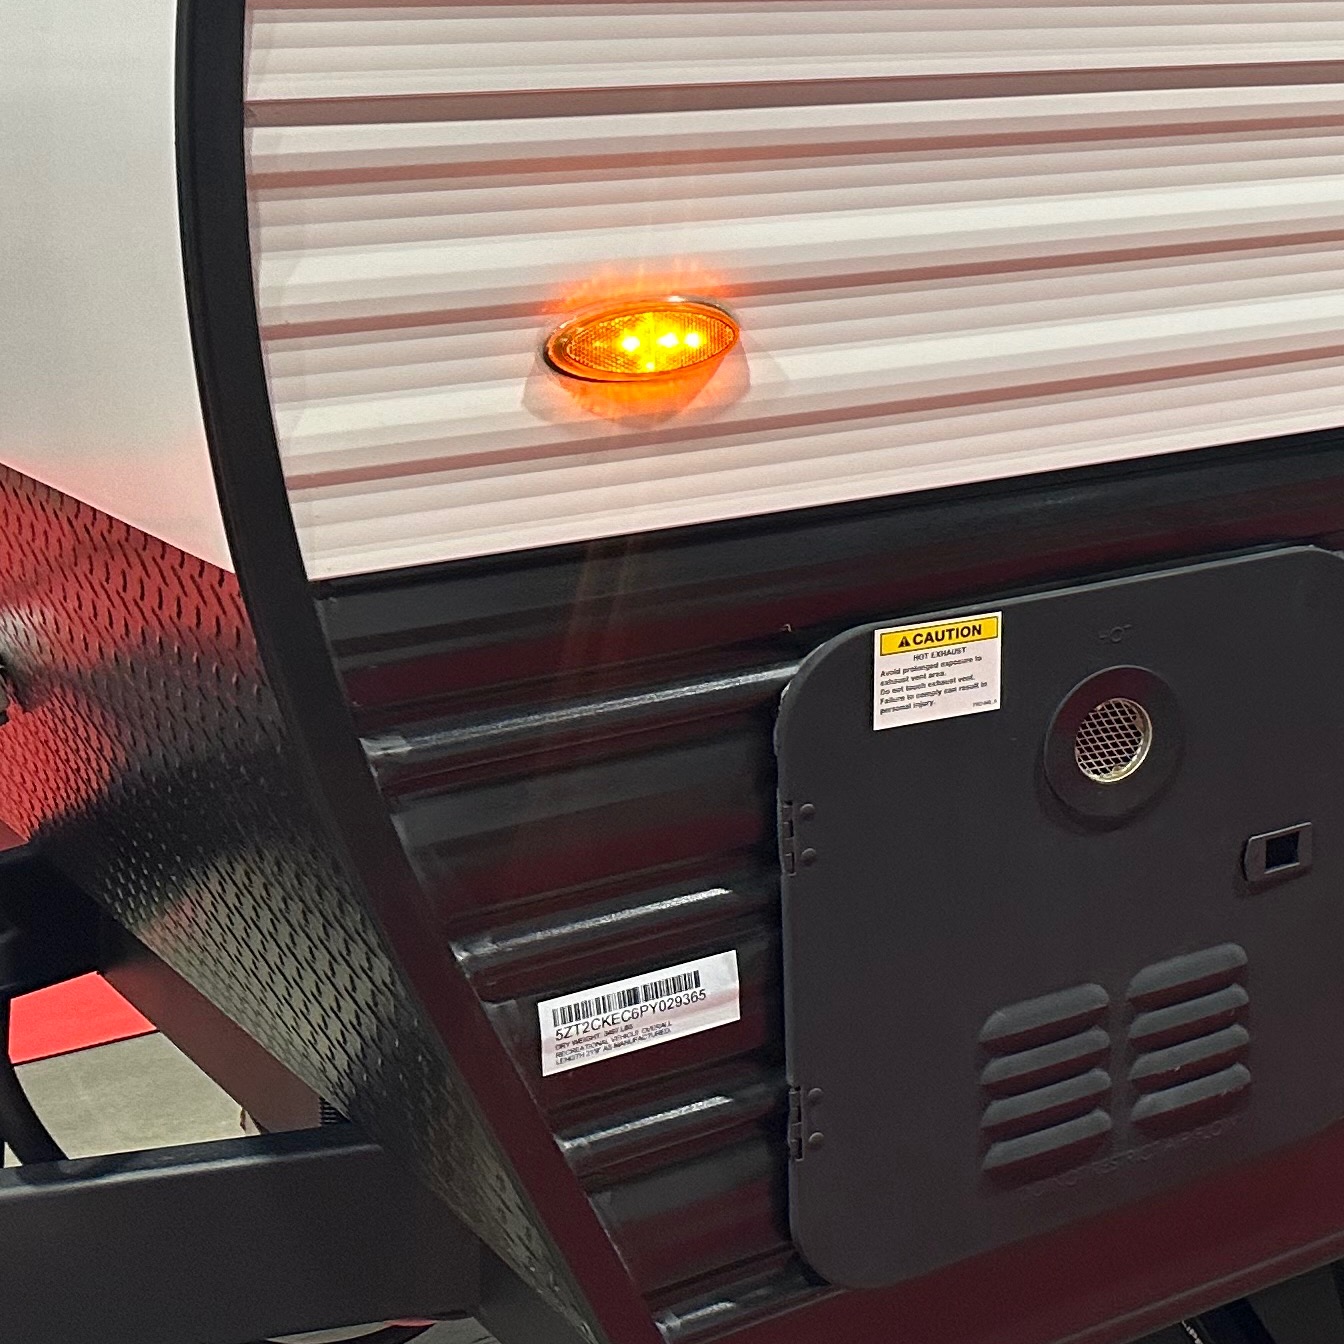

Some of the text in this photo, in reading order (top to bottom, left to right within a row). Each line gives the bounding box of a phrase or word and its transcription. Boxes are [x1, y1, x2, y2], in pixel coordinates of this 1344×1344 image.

[912, 623, 982, 645] CAUTION
[913, 646, 967, 661] HOT EXHAUST
[880, 668, 901, 677] Avoid
[902, 662, 939, 675] prolonged
[940, 657, 974, 667] exposure
[880, 671, 947, 687] exhaust vent area.
[880, 688, 890, 696] Do
[927, 677, 957, 688] exhaust
[880, 695, 905, 705] Failure
[915, 689, 942, 699] comply
[943, 687, 957, 695] can
[958, 682, 979, 692] result
[880, 703, 912, 715] personal
[555, 988, 707, 1042] 5ZT2CKEC6PY029365
[555, 1041, 570, 1051] DRY
[555, 1039, 609, 1059] RECREATIONAL
